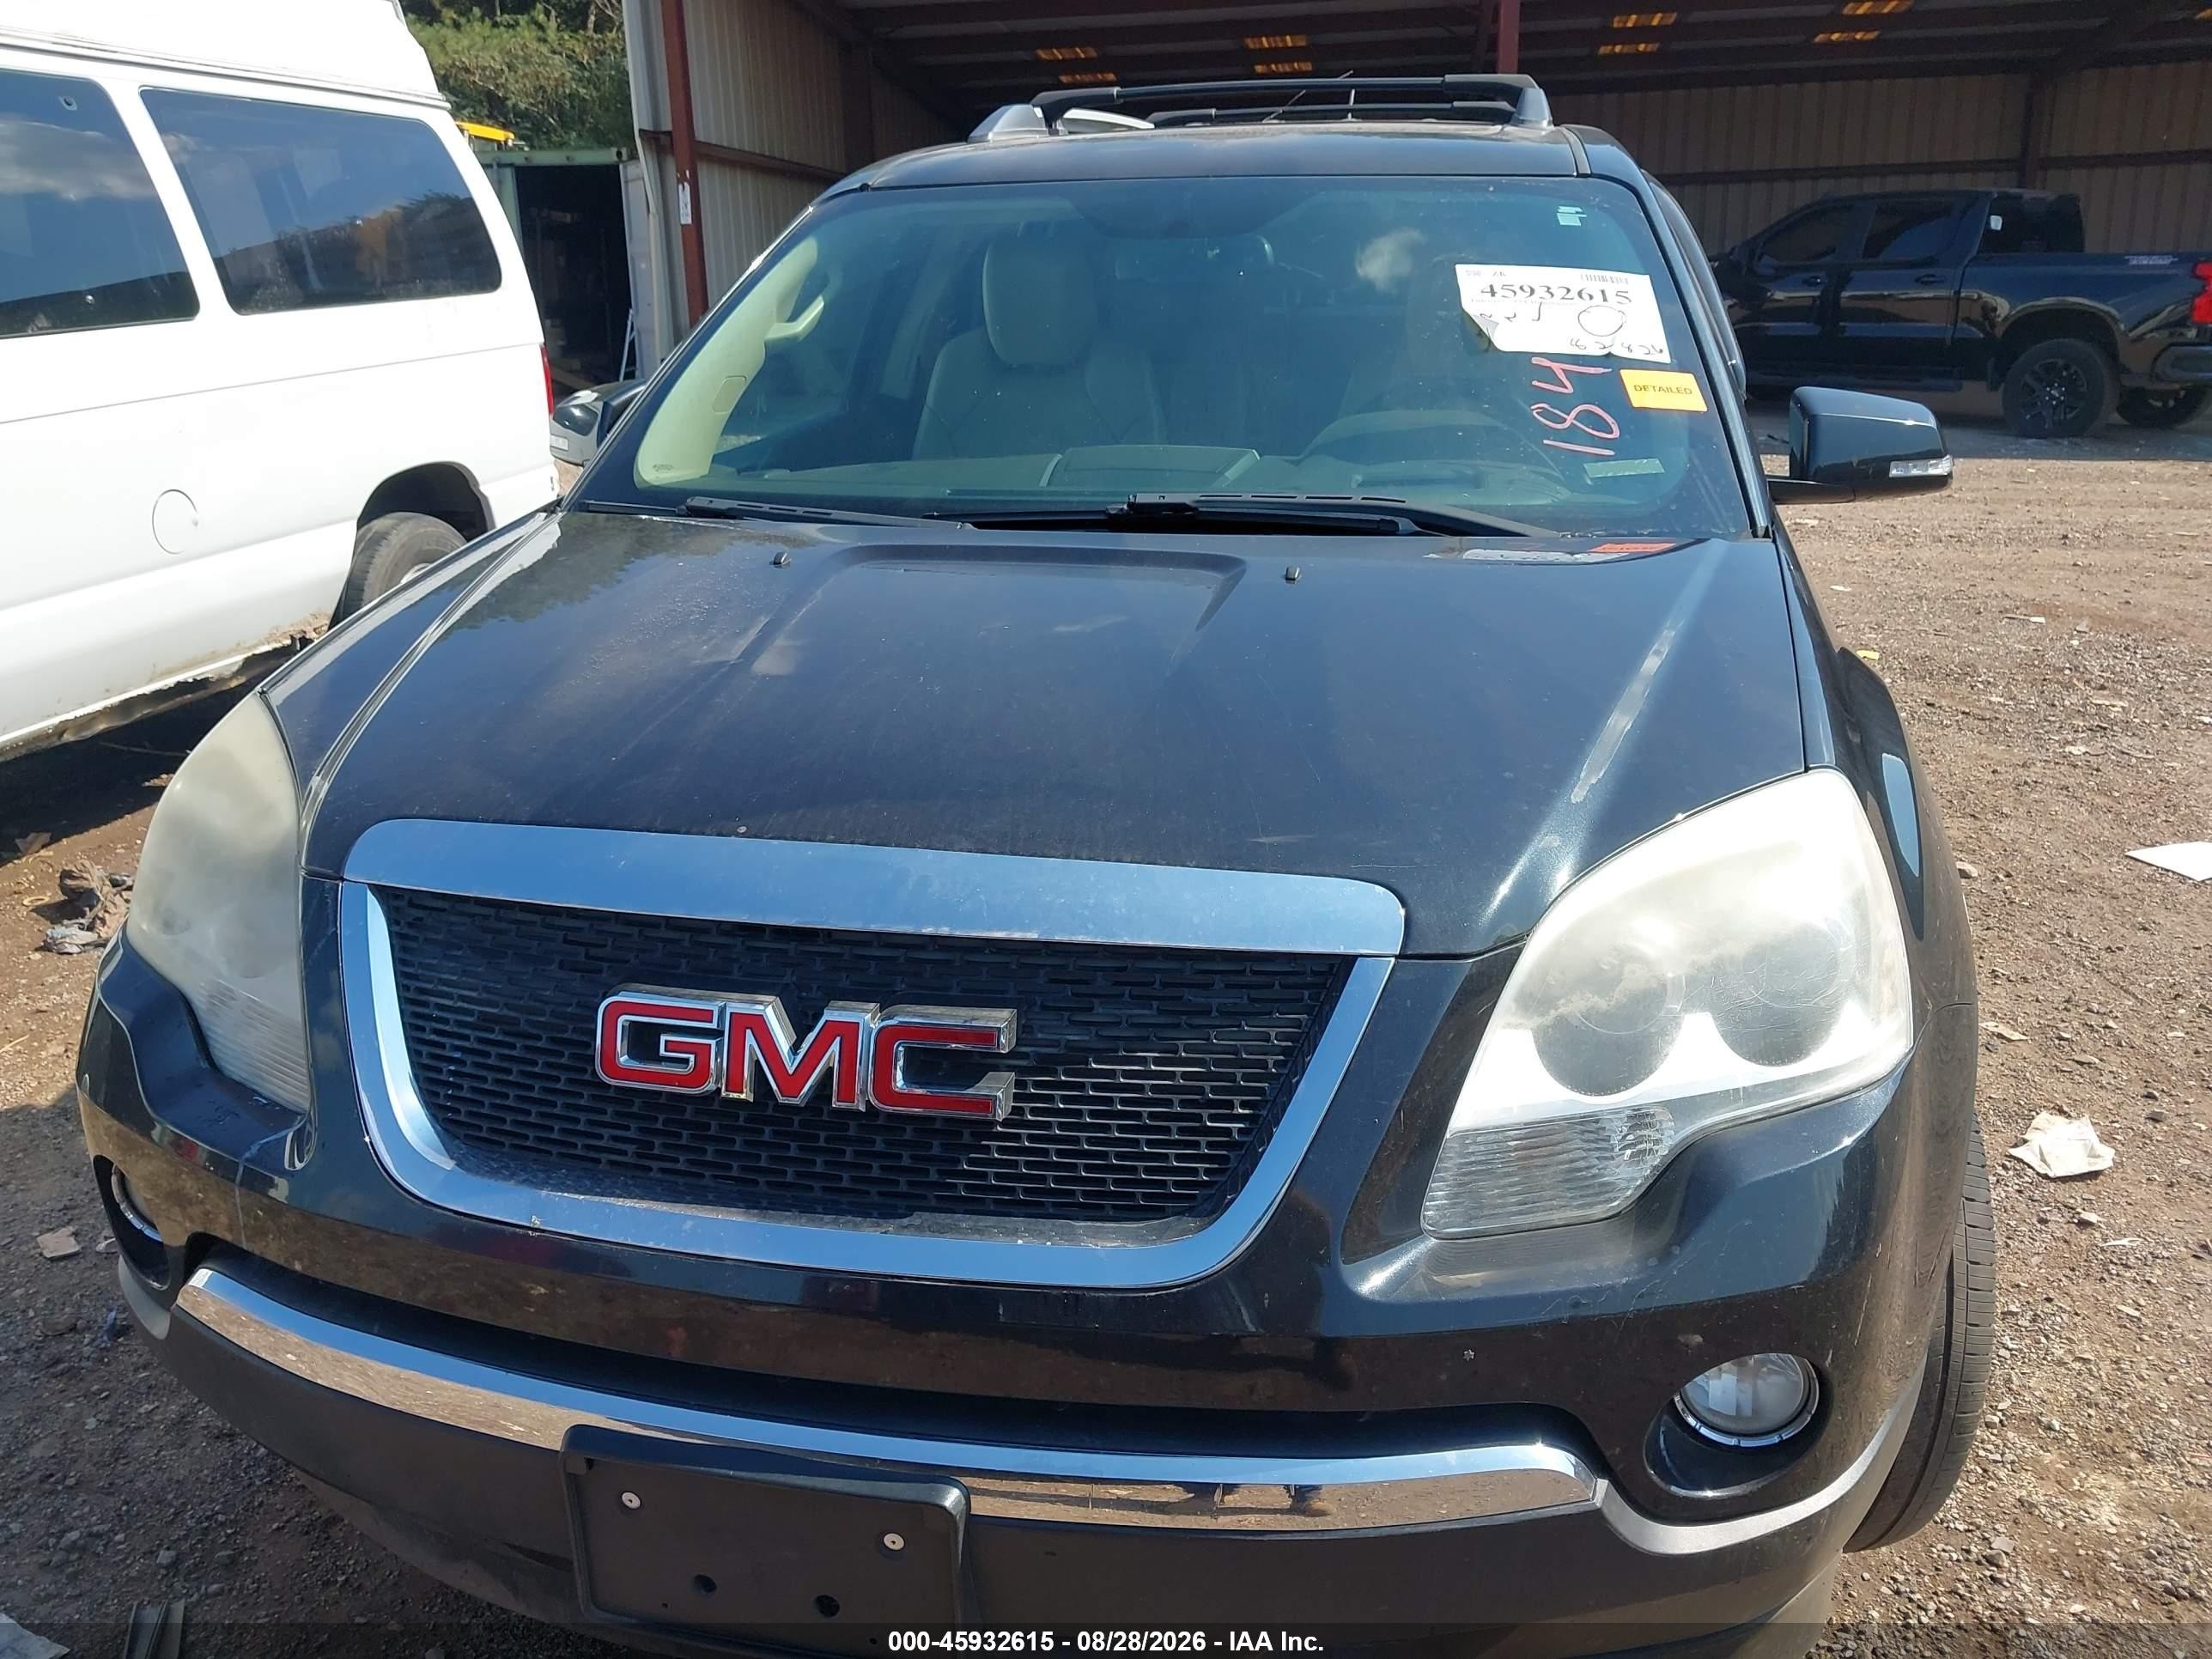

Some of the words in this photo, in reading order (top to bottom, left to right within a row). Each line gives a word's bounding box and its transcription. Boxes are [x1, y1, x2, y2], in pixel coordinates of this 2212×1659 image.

[1480, 283, 1632, 305] 45932615
[1633, 384, 1693, 395] DETAILED
[595, 983, 1018, 1121] GMC
